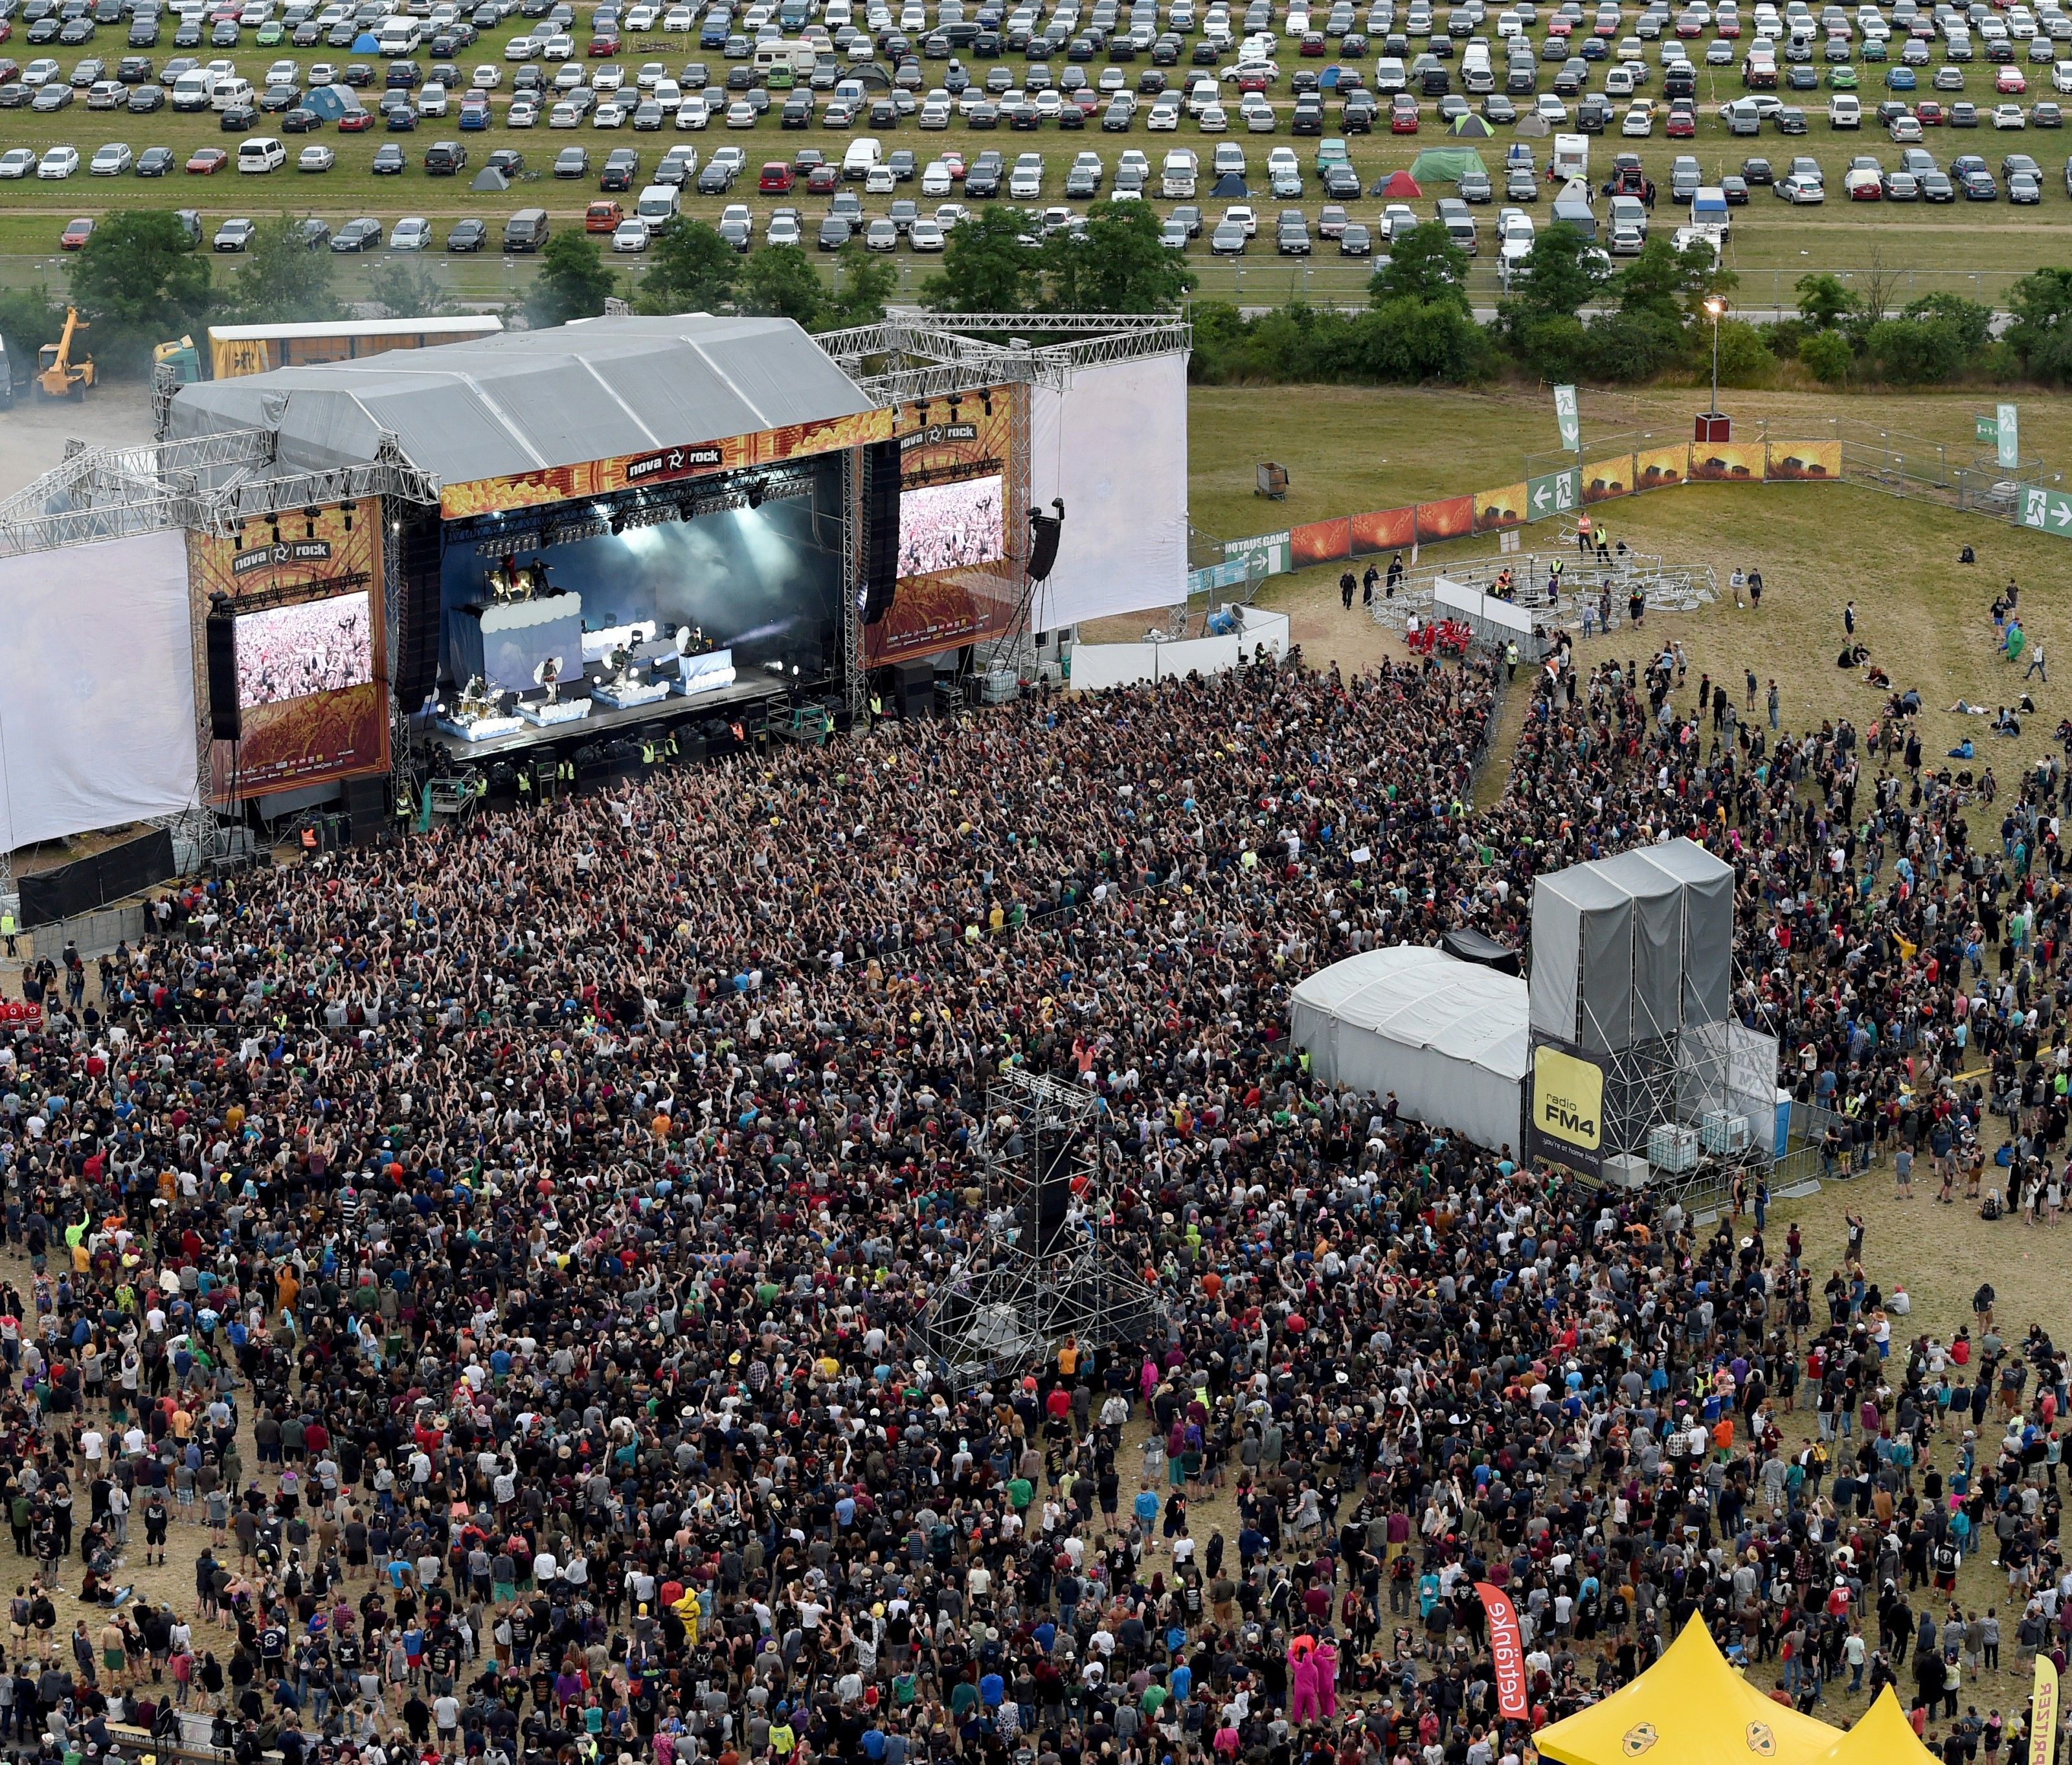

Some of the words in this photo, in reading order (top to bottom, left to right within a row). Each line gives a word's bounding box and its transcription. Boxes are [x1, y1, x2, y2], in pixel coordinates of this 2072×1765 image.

[948, 426, 973, 437] rock
[629, 458, 662, 477] nova
[690, 450, 719, 463] rock
[1225, 532, 1290, 554] NOTAUSGANG
[235, 552, 267, 570] nova
[296, 543, 326, 556] rock
[1546, 1093, 1577, 1111] radio
[1546, 1103, 1595, 1138] FM4
[1568, 1147, 1584, 1158] home
[1584, 1153, 1599, 1165] baby
[1837, 1591, 1848, 1602] 10
